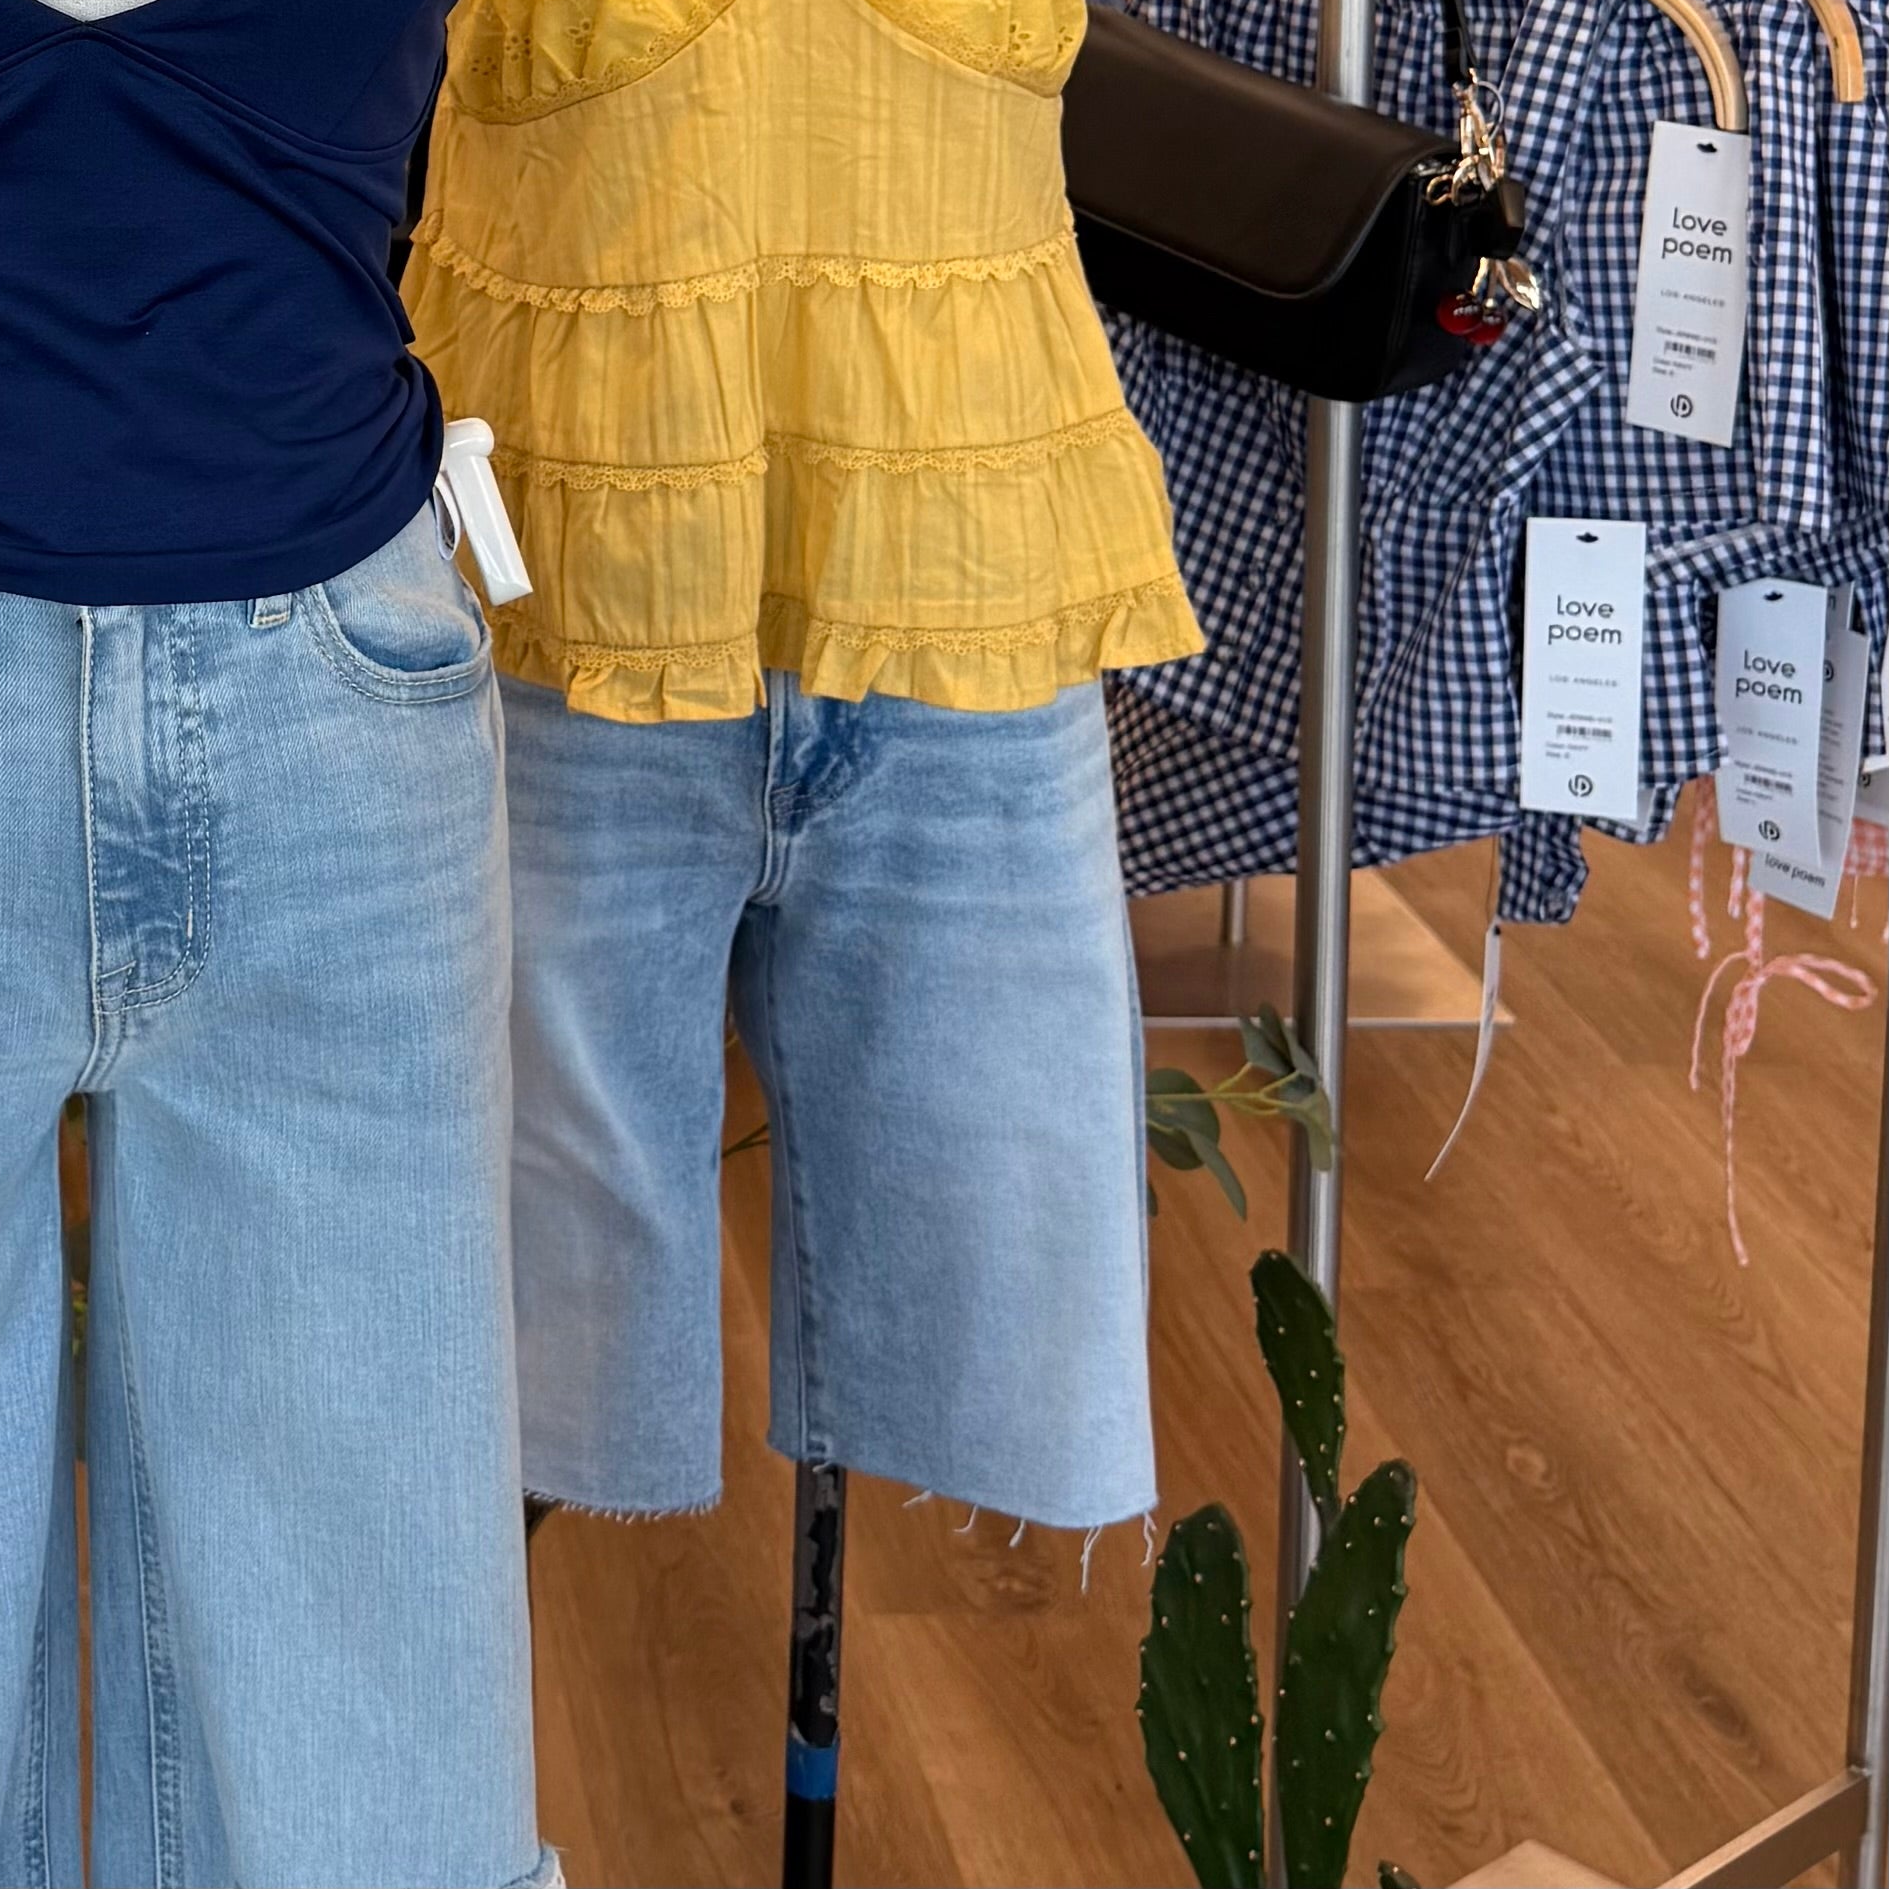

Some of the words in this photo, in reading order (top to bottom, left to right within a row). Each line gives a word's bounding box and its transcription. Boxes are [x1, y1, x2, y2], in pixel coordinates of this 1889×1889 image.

[1661, 236, 1733, 265] poem
[1548, 623, 1623, 645] poem
[1735, 677, 1803, 705] poem
[1791, 867, 1827, 888] poem
